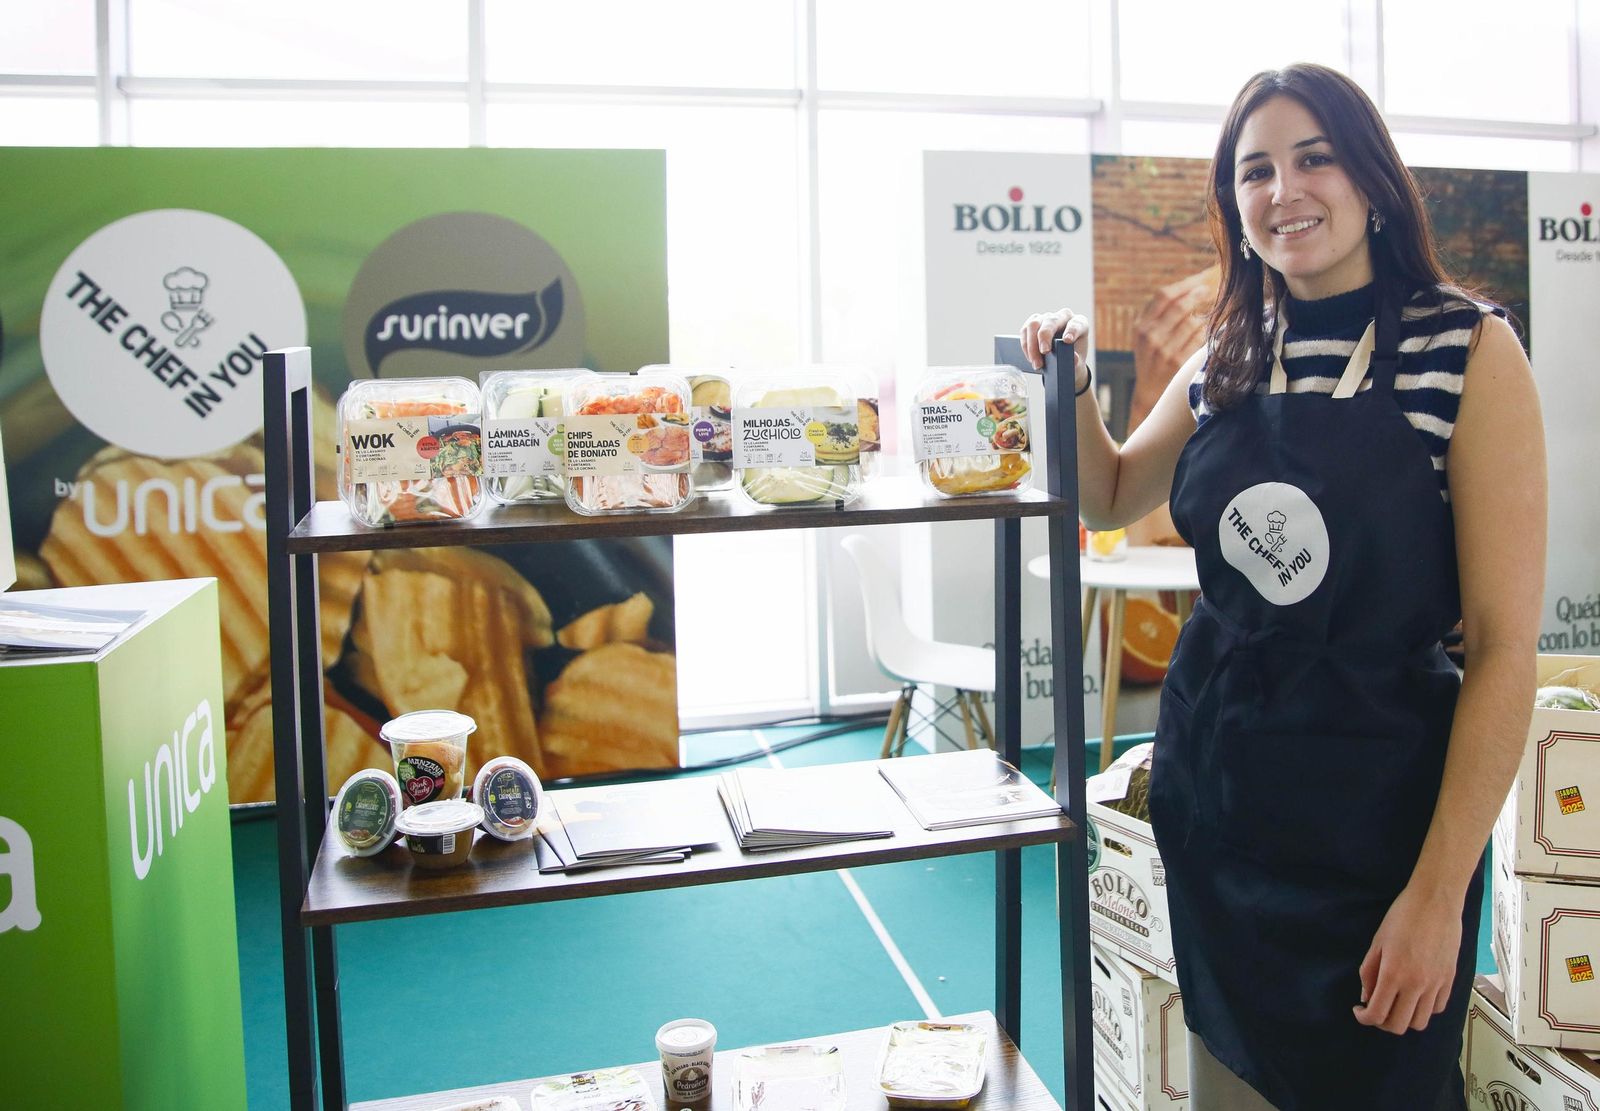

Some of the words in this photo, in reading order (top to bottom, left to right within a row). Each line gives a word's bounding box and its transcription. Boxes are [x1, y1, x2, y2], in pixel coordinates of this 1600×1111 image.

[953, 204, 1082, 232] BOLLO
[1538, 217, 1600, 242] BOL
[977, 240, 1025, 254] Desde
[1028, 241, 1061, 254] 1922
[376, 305, 530, 341] surinver
[66, 271, 128, 334] THE
[120, 324, 198, 390] CHEF
[184, 381, 222, 418] IN
[210, 332, 268, 389] YOU
[922, 406, 947, 415] TIRAS
[743, 419, 790, 428] MILHOJAS
[922, 414, 962, 424] PIMIENTO
[488, 428, 530, 438] LÁMINAS
[568, 431, 592, 440] CHIPS
[351, 433, 395, 450] WOK
[488, 437, 540, 448] CALABACÍN
[568, 440, 620, 449] ONDULADAS
[581, 449, 617, 458] BONIATO
[54, 478, 80, 501] by
[1228, 507, 1253, 540] THE
[1248, 537, 1285, 570] CHEF
[1278, 568, 1292, 587] IN
[1289, 548, 1312, 575] YOU
[1538, 632, 1569, 650] con
[1572, 624, 1588, 648] lo
[408, 758, 444, 774] MANZANA
[410, 779, 427, 791] Pink
[414, 786, 430, 796] Lady
[1560, 787, 1578, 796] SABOR
[1562, 802, 1584, 814] 2025
[1091, 873, 1148, 918] BOLLO
[1097, 893, 1137, 920] Melones
[1092, 902, 1125, 924] ETIQUETA
[1125, 919, 1148, 936] NEGRA
[1570, 956, 1588, 964] SABOR
[1571, 970, 1593, 982] 2025
